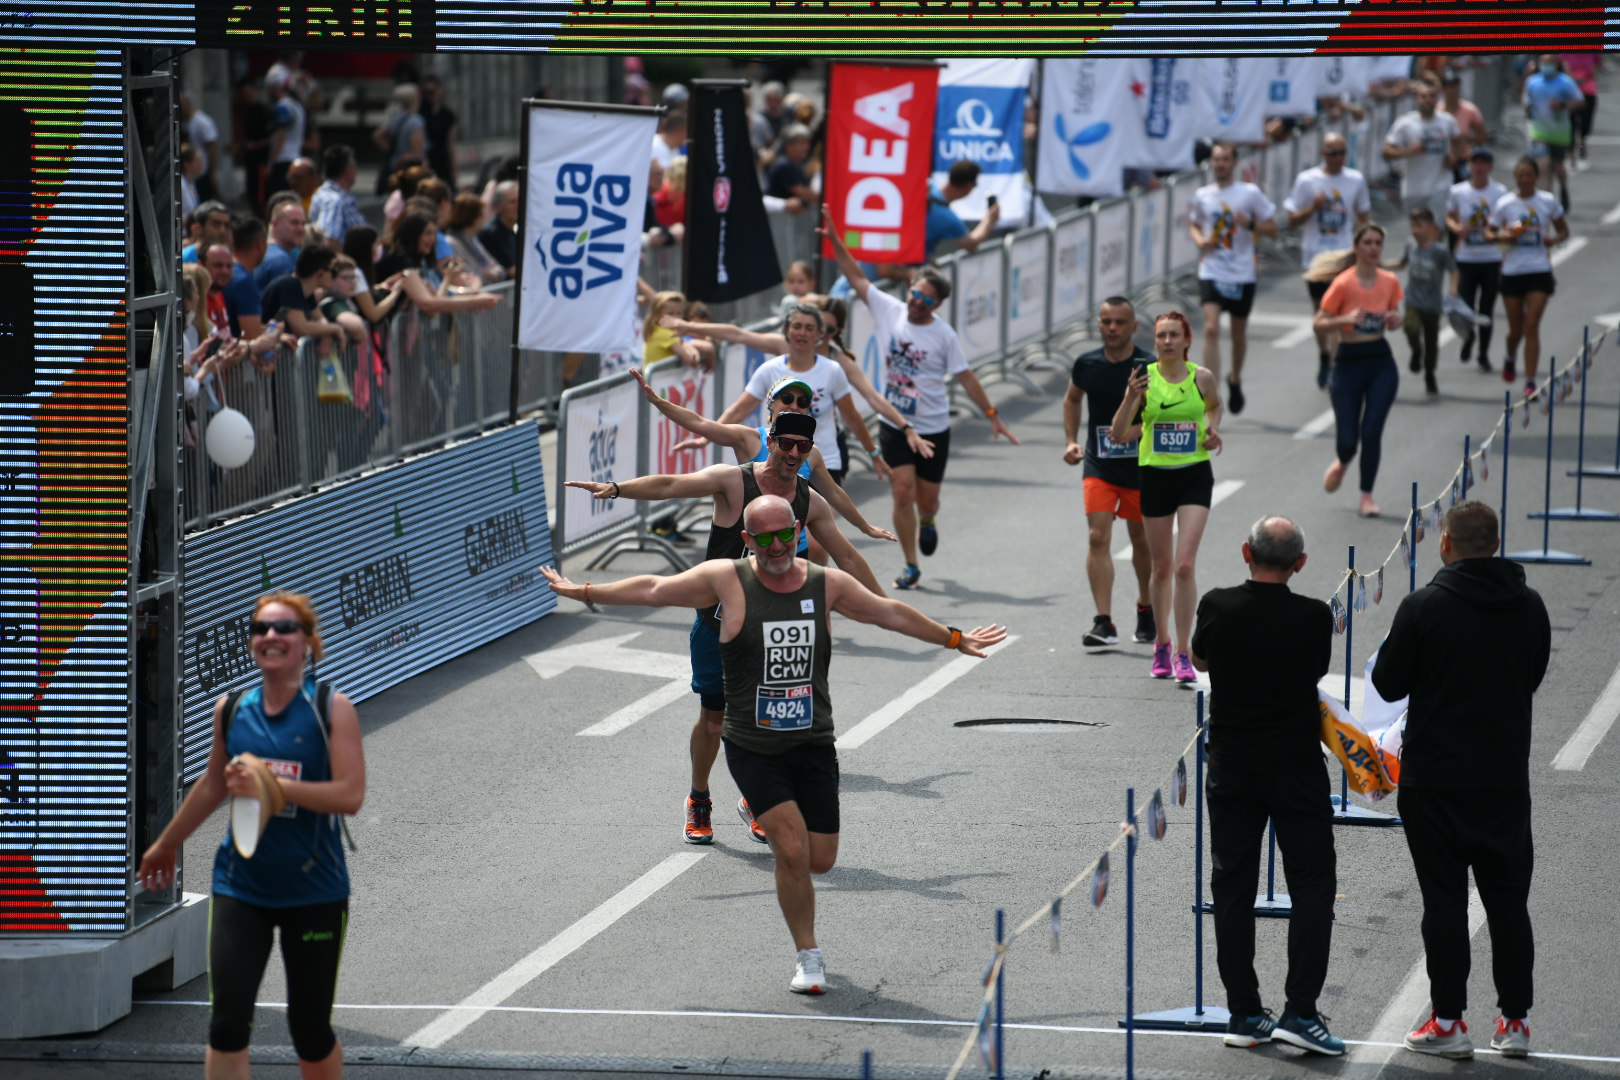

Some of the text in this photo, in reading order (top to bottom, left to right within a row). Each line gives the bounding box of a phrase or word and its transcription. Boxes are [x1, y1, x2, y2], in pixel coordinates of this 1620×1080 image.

[713, 108, 727, 174] VISION
[938, 139, 1015, 161] UNIQA
[1160, 432, 1192, 447] 6307
[340, 552, 412, 631] GARMIN
[770, 626, 810, 644] 091
[769, 646, 809, 663] RUN
[765, 700, 806, 719] 4924
